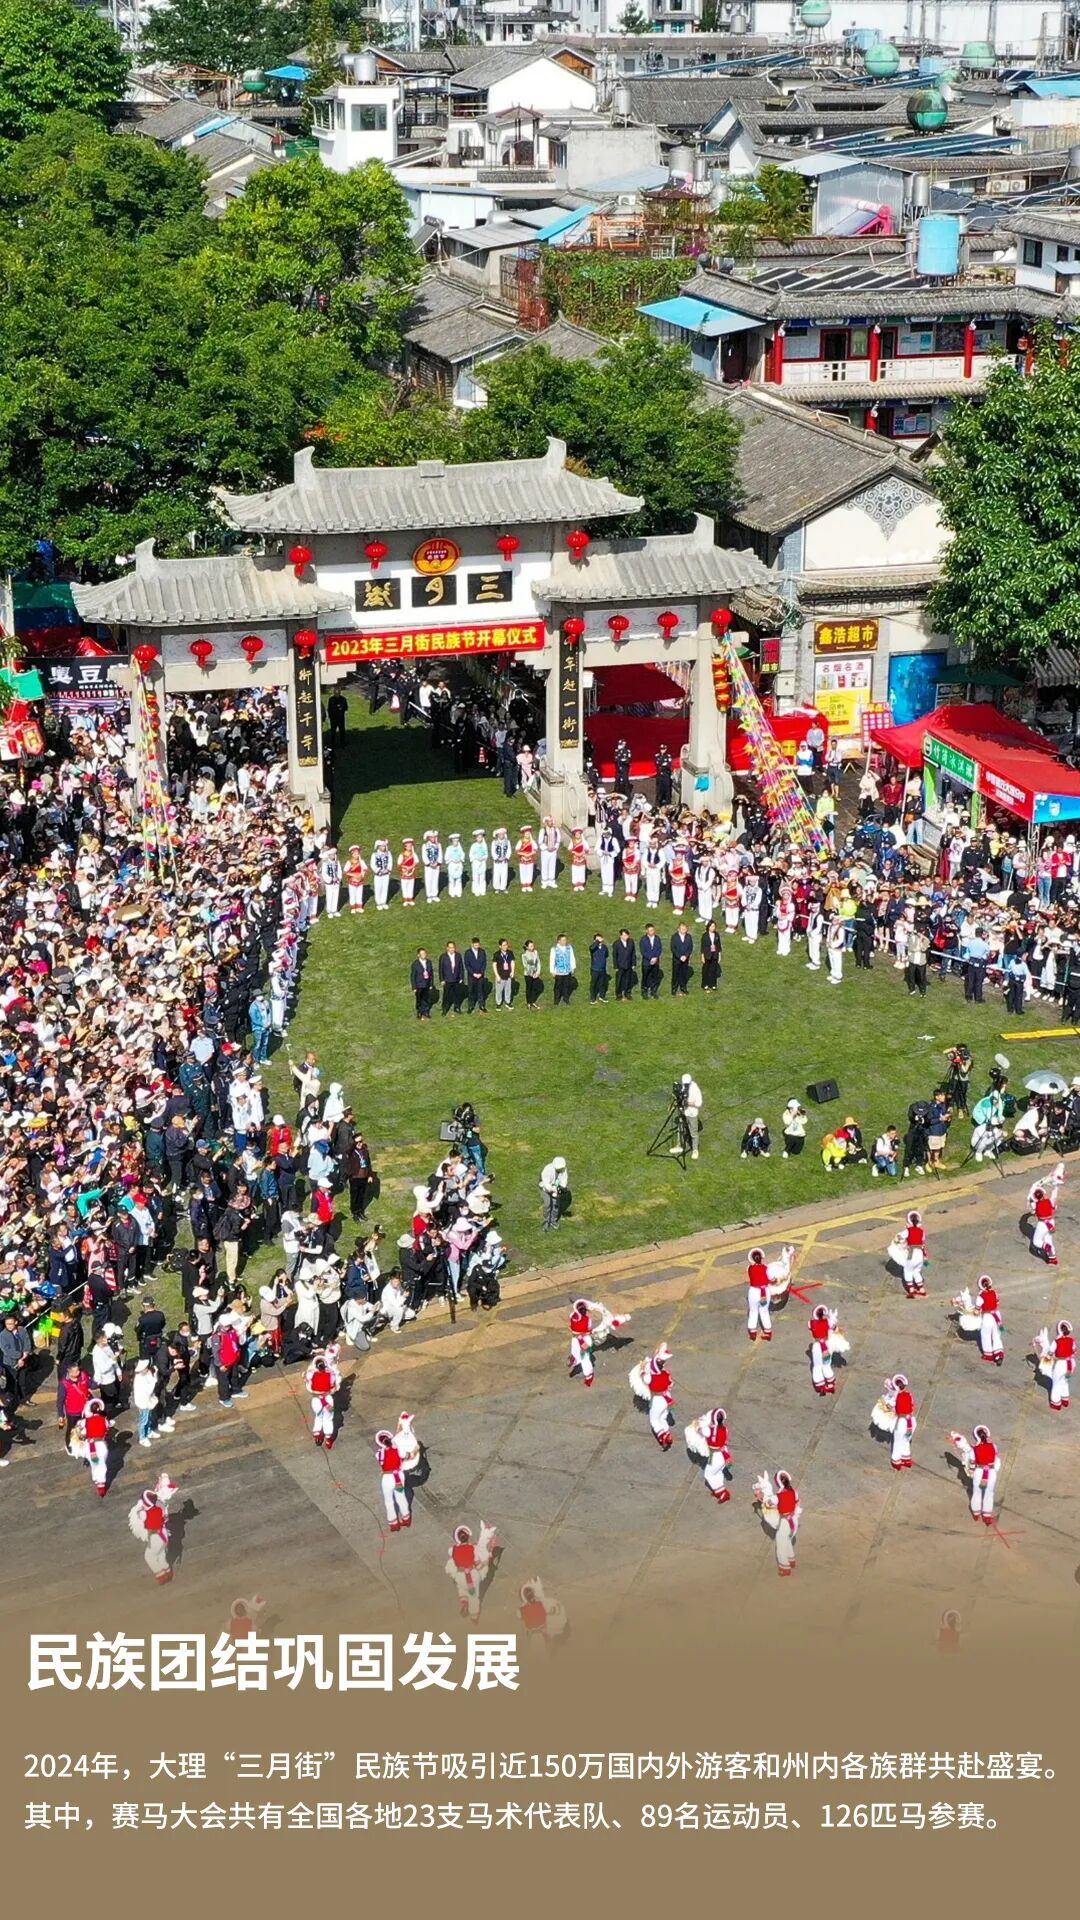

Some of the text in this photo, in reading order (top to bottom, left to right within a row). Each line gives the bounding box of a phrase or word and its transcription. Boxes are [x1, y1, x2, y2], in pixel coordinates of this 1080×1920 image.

[331, 626, 537, 657] 2023年三月街民族节开幕仪式
[819, 625, 875, 645] 鑫浩超市
[29, 663, 128, 685] 臭豆
